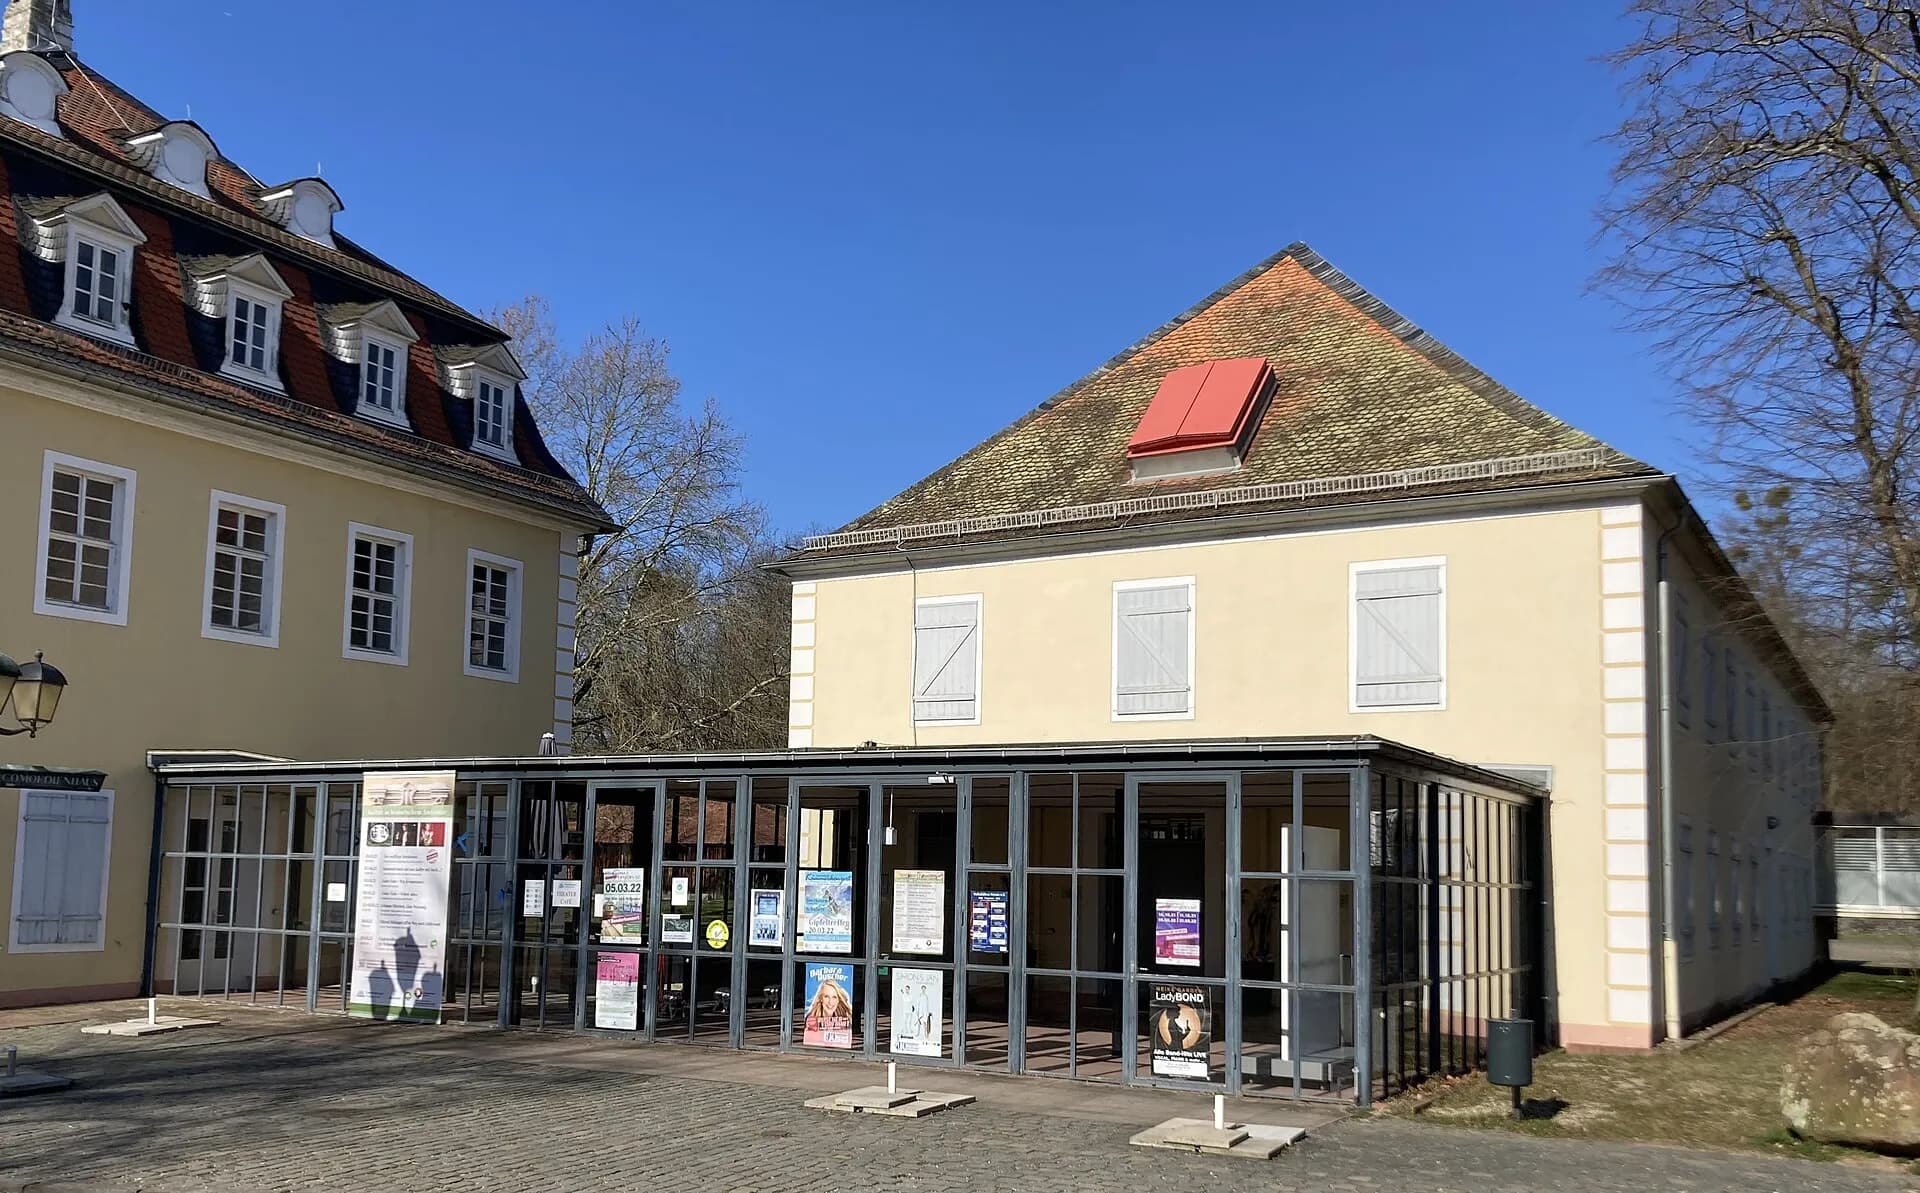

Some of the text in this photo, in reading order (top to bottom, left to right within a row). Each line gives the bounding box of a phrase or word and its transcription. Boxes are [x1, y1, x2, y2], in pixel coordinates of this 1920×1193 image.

[605, 883, 641, 893] 05.03.22
[809, 966, 843, 978] Barbara
[1155, 992, 1204, 1003] LadyBOND
